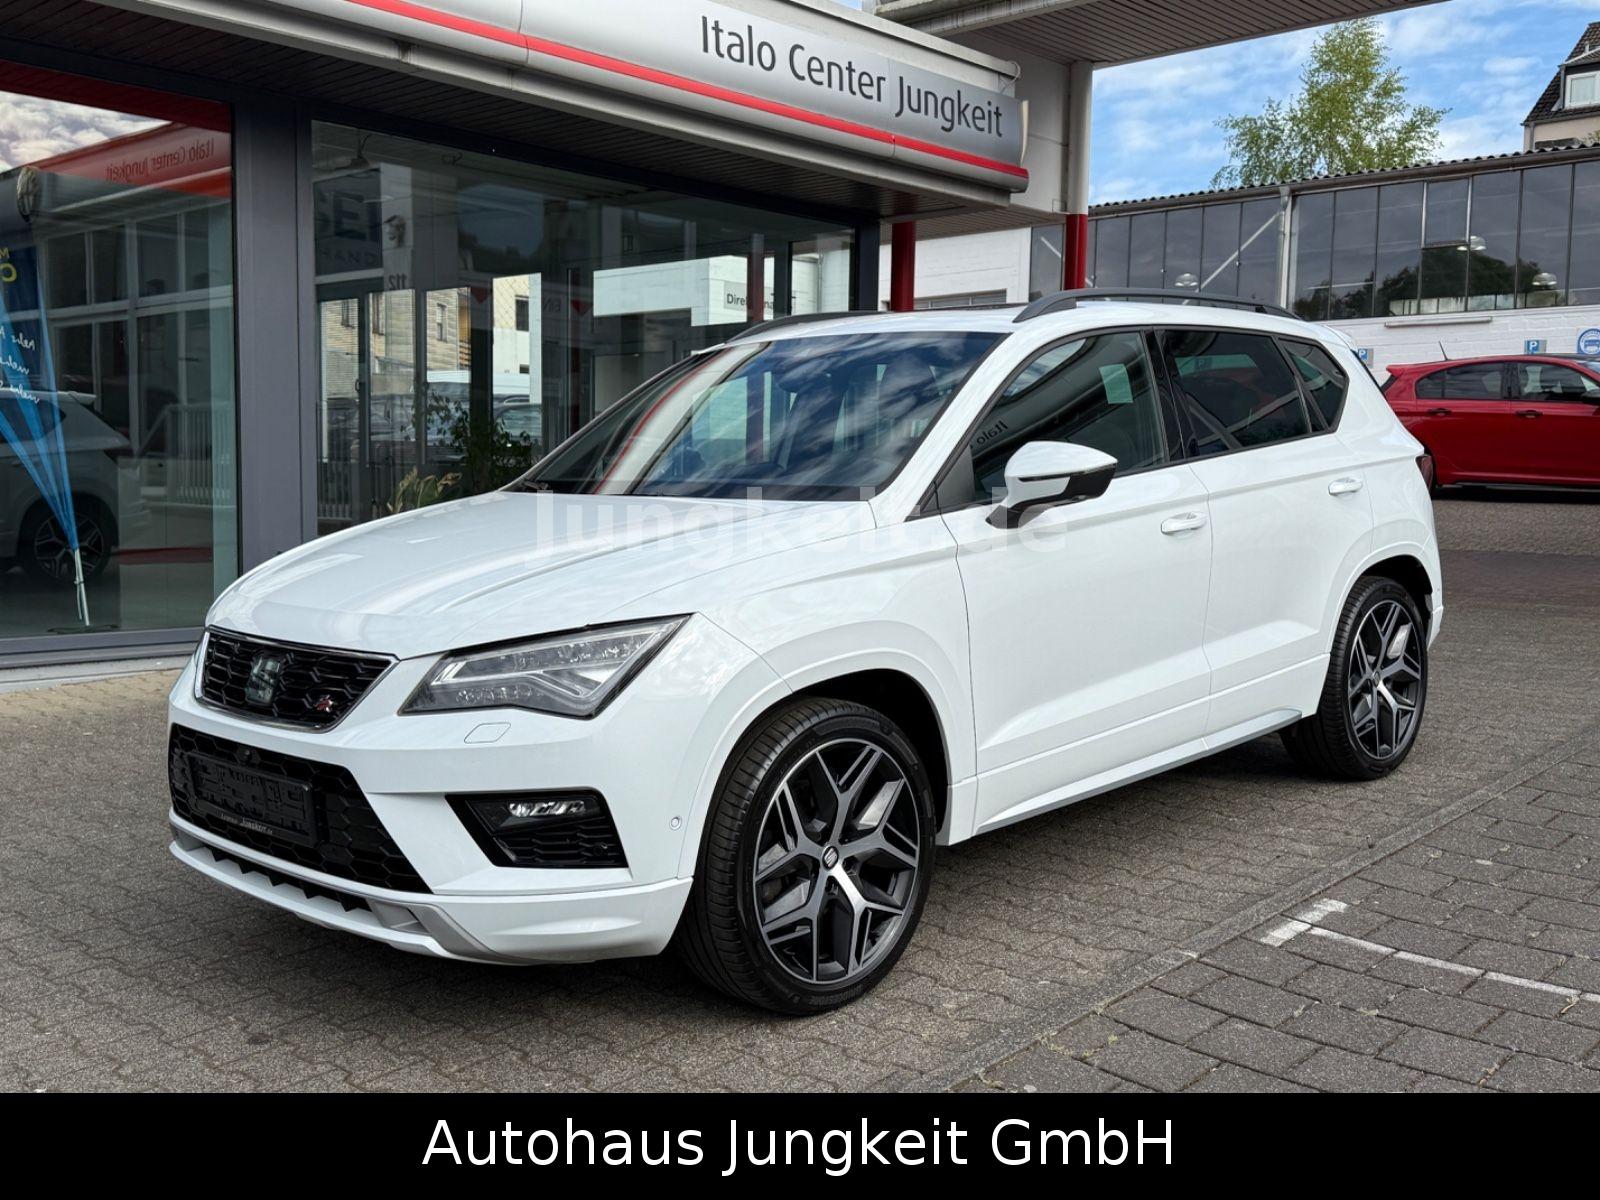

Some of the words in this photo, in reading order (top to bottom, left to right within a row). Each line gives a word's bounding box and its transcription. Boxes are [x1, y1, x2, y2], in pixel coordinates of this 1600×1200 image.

[702, 15, 776, 72] Italo
[788, 44, 886, 103] Center
[895, 75, 1003, 138] Jungkeit
